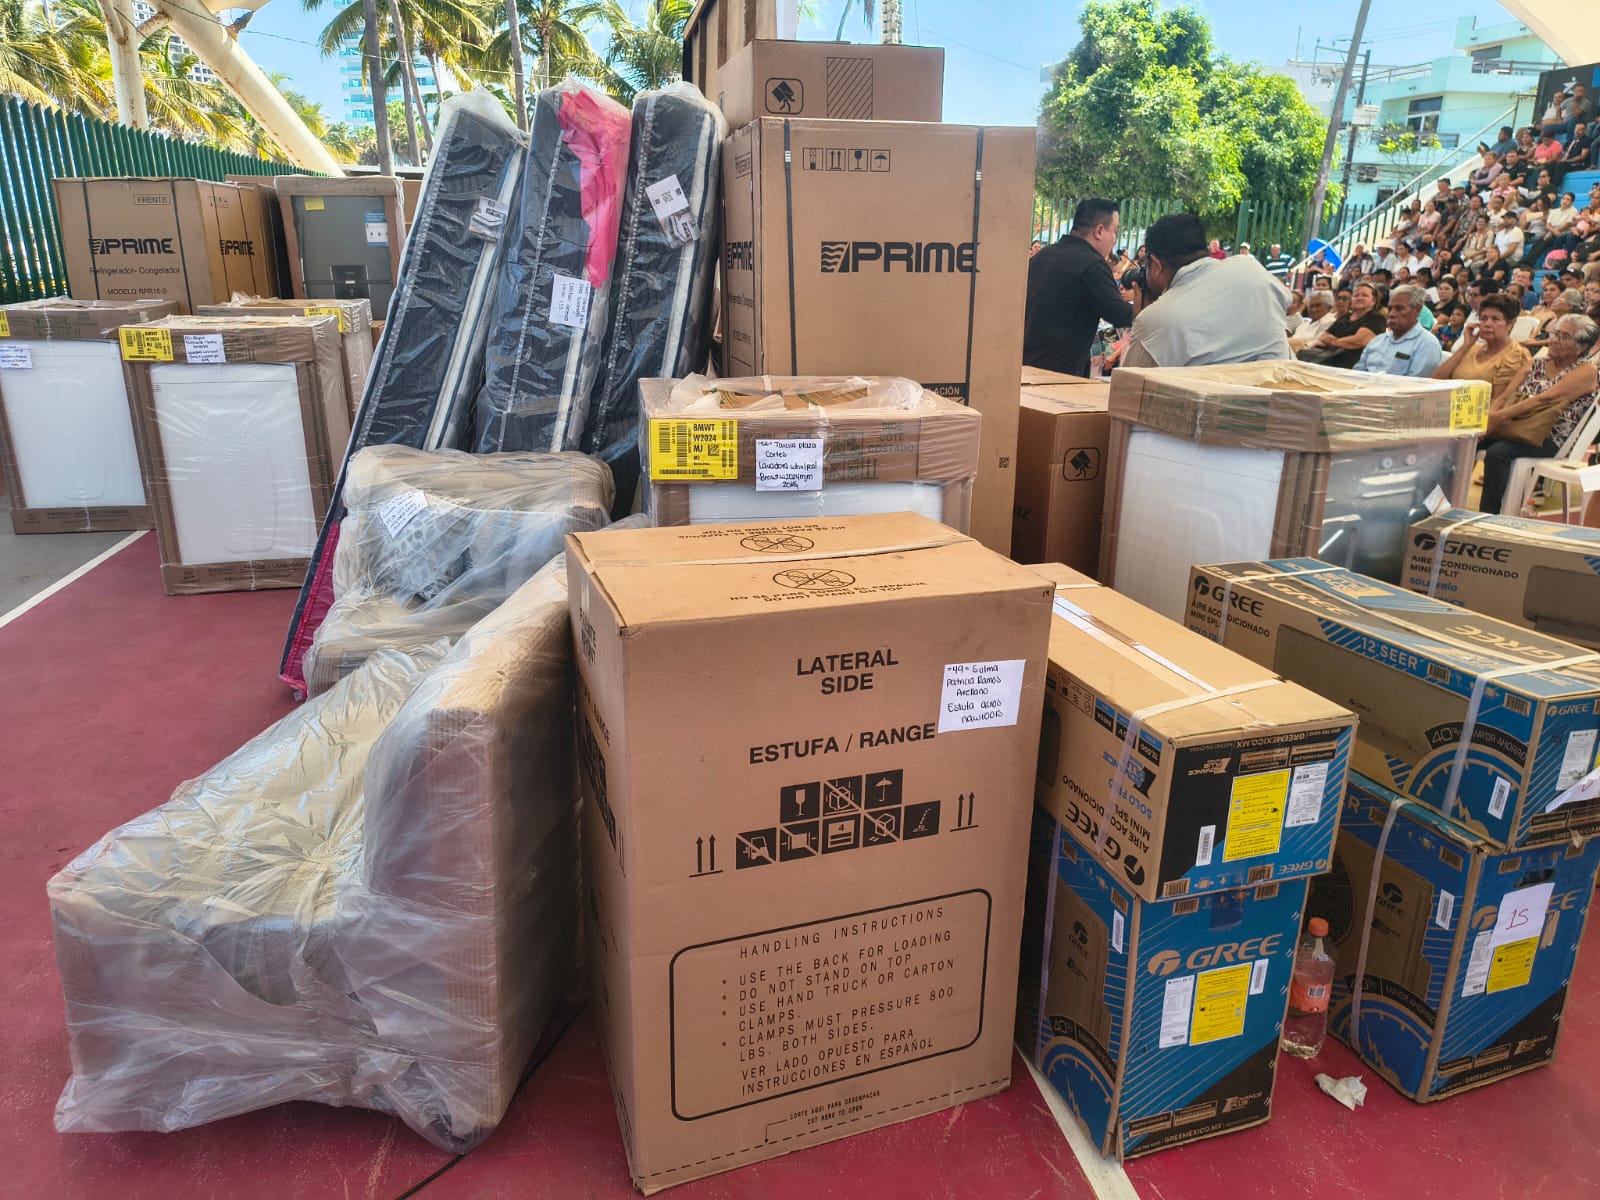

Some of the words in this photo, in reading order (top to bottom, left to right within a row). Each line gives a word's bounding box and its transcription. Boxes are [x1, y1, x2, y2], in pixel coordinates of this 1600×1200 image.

[106, 238, 176, 255] PRIME
[226, 239, 256, 256] PRIME
[852, 242, 981, 273] PRIME
[139, 267, 180, 276] Congelador
[693, 423, 715, 432] BMWT
[693, 434, 717, 442] W2024
[693, 445, 703, 453] MJ
[1443, 540, 1512, 563] GREE
[1410, 564, 1431, 573] MINI
[1437, 569, 1459, 578] PLIT
[1411, 555, 1433, 565] AIRE
[1438, 560, 1519, 579] CONDICIONADO
[872, 581, 928, 590] EMPAQUE
[1212, 585, 1264, 618] GREE
[1190, 610, 1206, 621] MINI
[1191, 600, 1207, 612] AIRE
[1208, 607, 1270, 638] ACODICIONADO
[1361, 635, 1378, 654] 12
[1379, 645, 1420, 671] SEER
[1444, 624, 1565, 660] GREE
[797, 648, 899, 676] LATERAL
[820, 673, 874, 696] SIDE
[1558, 703, 1591, 715] GREE
[749, 737, 839, 764] ESTUFA
[846, 733, 854, 753] /
[859, 722, 936, 750] RANGE
[1236, 733, 1305, 748] GREEMEXICO.MX
[1062, 775, 1128, 836] ACODICIONADO
[1129, 795, 1152, 819] SOLO
[1065, 801, 1121, 861] GREE
[1130, 818, 1151, 841] MINI
[1128, 832, 1149, 853] AIRE
[1278, 861, 1314, 875] GREE
[740, 933, 821, 959] HANDLING
[833, 907, 945, 938] INSTRUCTIONS
[739, 970, 767, 986] USE
[777, 962, 803, 978] THE
[813, 953, 850, 970] BACK
[859, 944, 884, 959] FOR
[893, 930, 952, 951] LOADING
[1186, 933, 1283, 969] GREE
[739, 987, 758, 1001] DO
[769, 979, 796, 996] NOT
[805, 966, 850, 986] STAND
[860, 960, 878, 974] ON
[888, 953, 912, 969] TOP
[739, 1001, 767, 1017] USE
[777, 990, 815, 1007] HAND
[824, 978, 868, 997] TRUCK
[878, 971, 895, 985] OR
[904, 958, 955, 979] CARTON
[739, 1025, 795, 1047] CLAMPS
[805, 1013, 842, 1032] MUST
[852, 994, 921, 1020] PRESSURE
[929, 986, 954, 1001] 800
[739, 1012, 801, 1032] CLAMPS.
[739, 1047, 771, 1062] LBS.
[783, 1034, 818, 1053] BOTH
[828, 1022, 874, 1042] SIDES.
[742, 1065, 766, 1081] VER
[776, 1054, 809, 1072] LADO
[818, 1039, 875, 1062] OPUESTO
[884, 1027, 914, 1046] PARA
[741, 1059, 846, 1096] INSTRUCCIONES
[855, 1053, 870, 1067] EN
[880, 1037, 934, 1060] ESPAÑOL
[790, 1110, 808, 1120] CORTE
